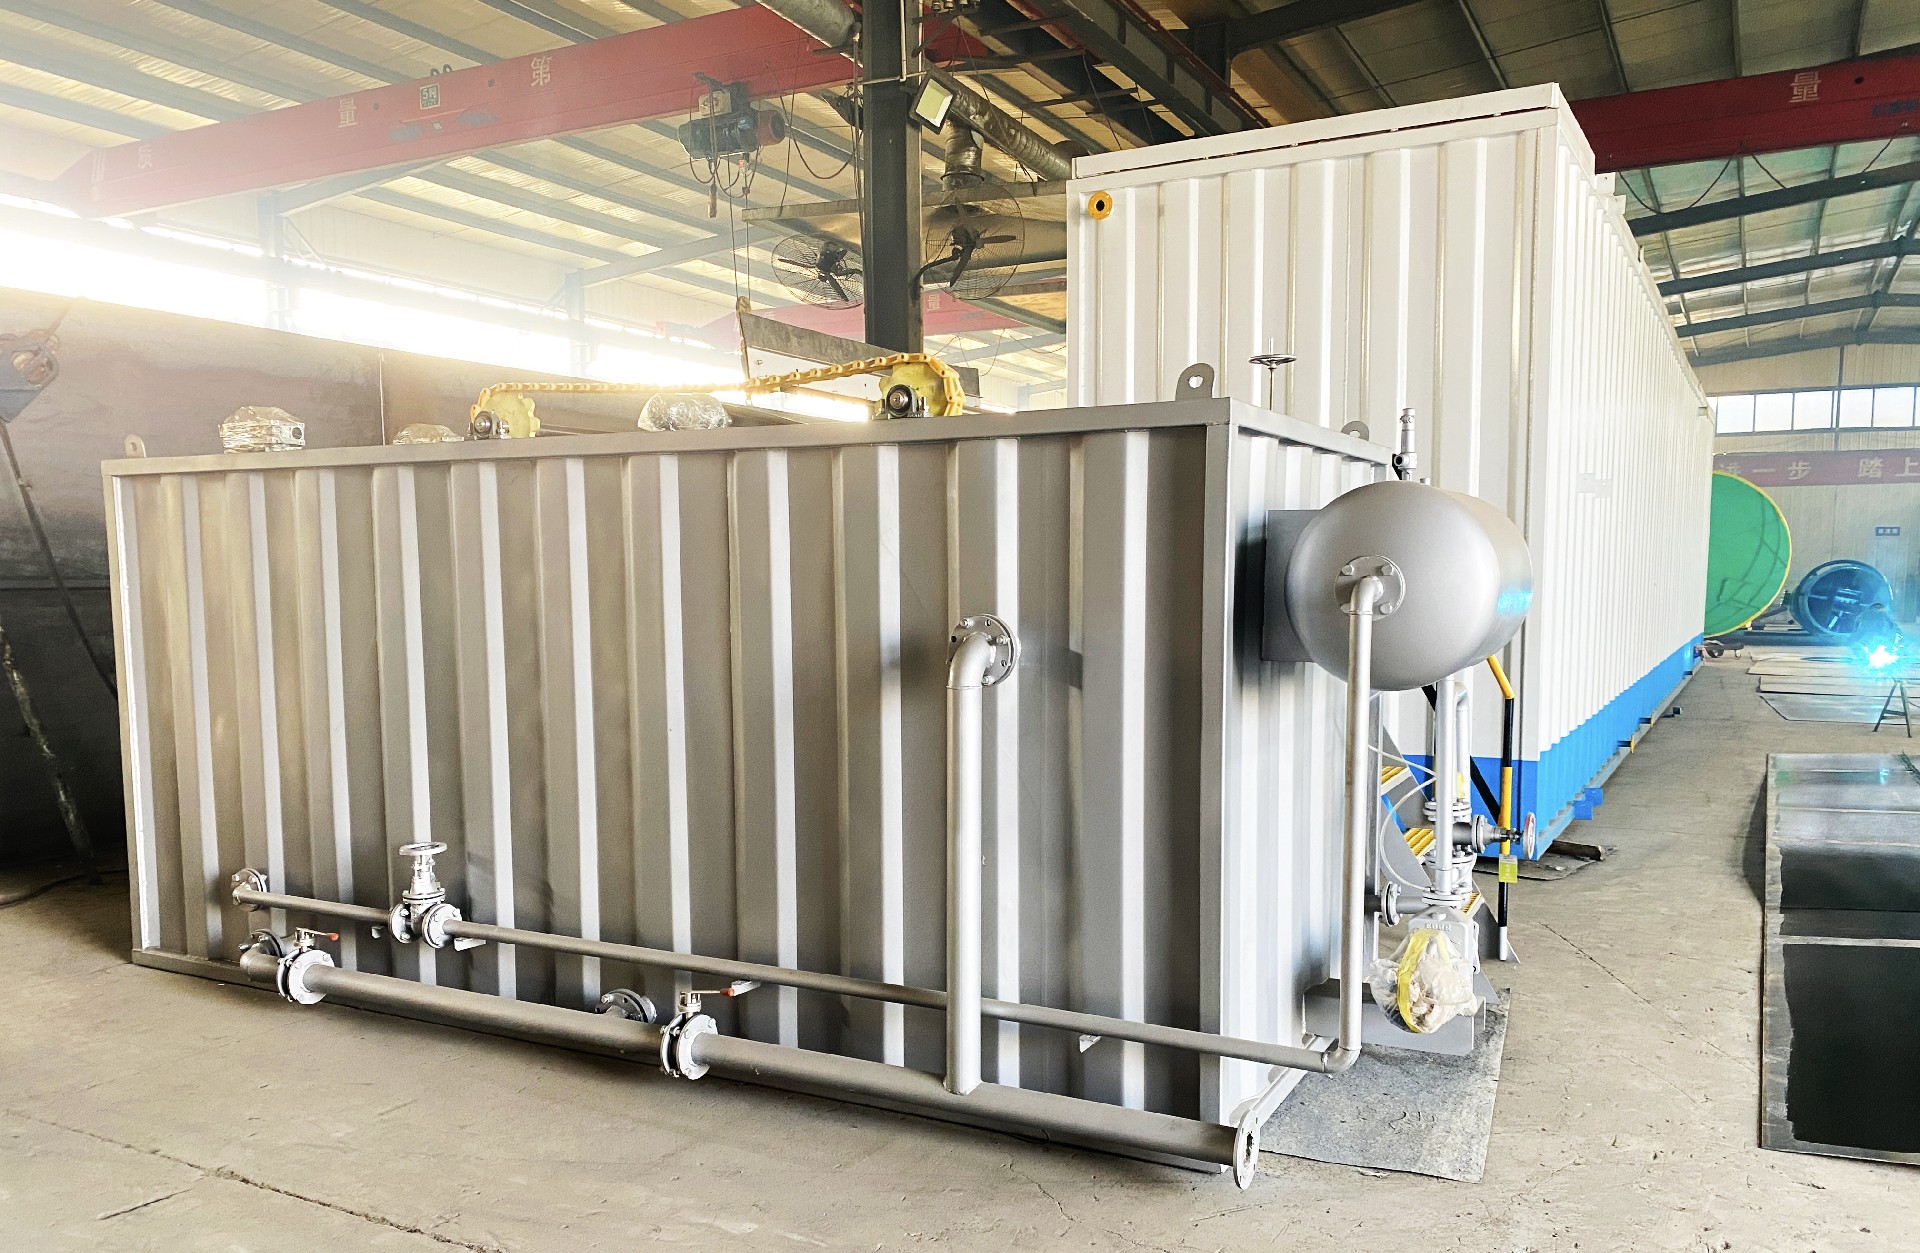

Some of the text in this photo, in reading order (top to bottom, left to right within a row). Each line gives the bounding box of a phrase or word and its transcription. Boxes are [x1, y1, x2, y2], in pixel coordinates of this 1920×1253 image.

[338, 98, 357, 128] 量
[531, 55, 553, 87] 第
[1789, 70, 1822, 103] 量
